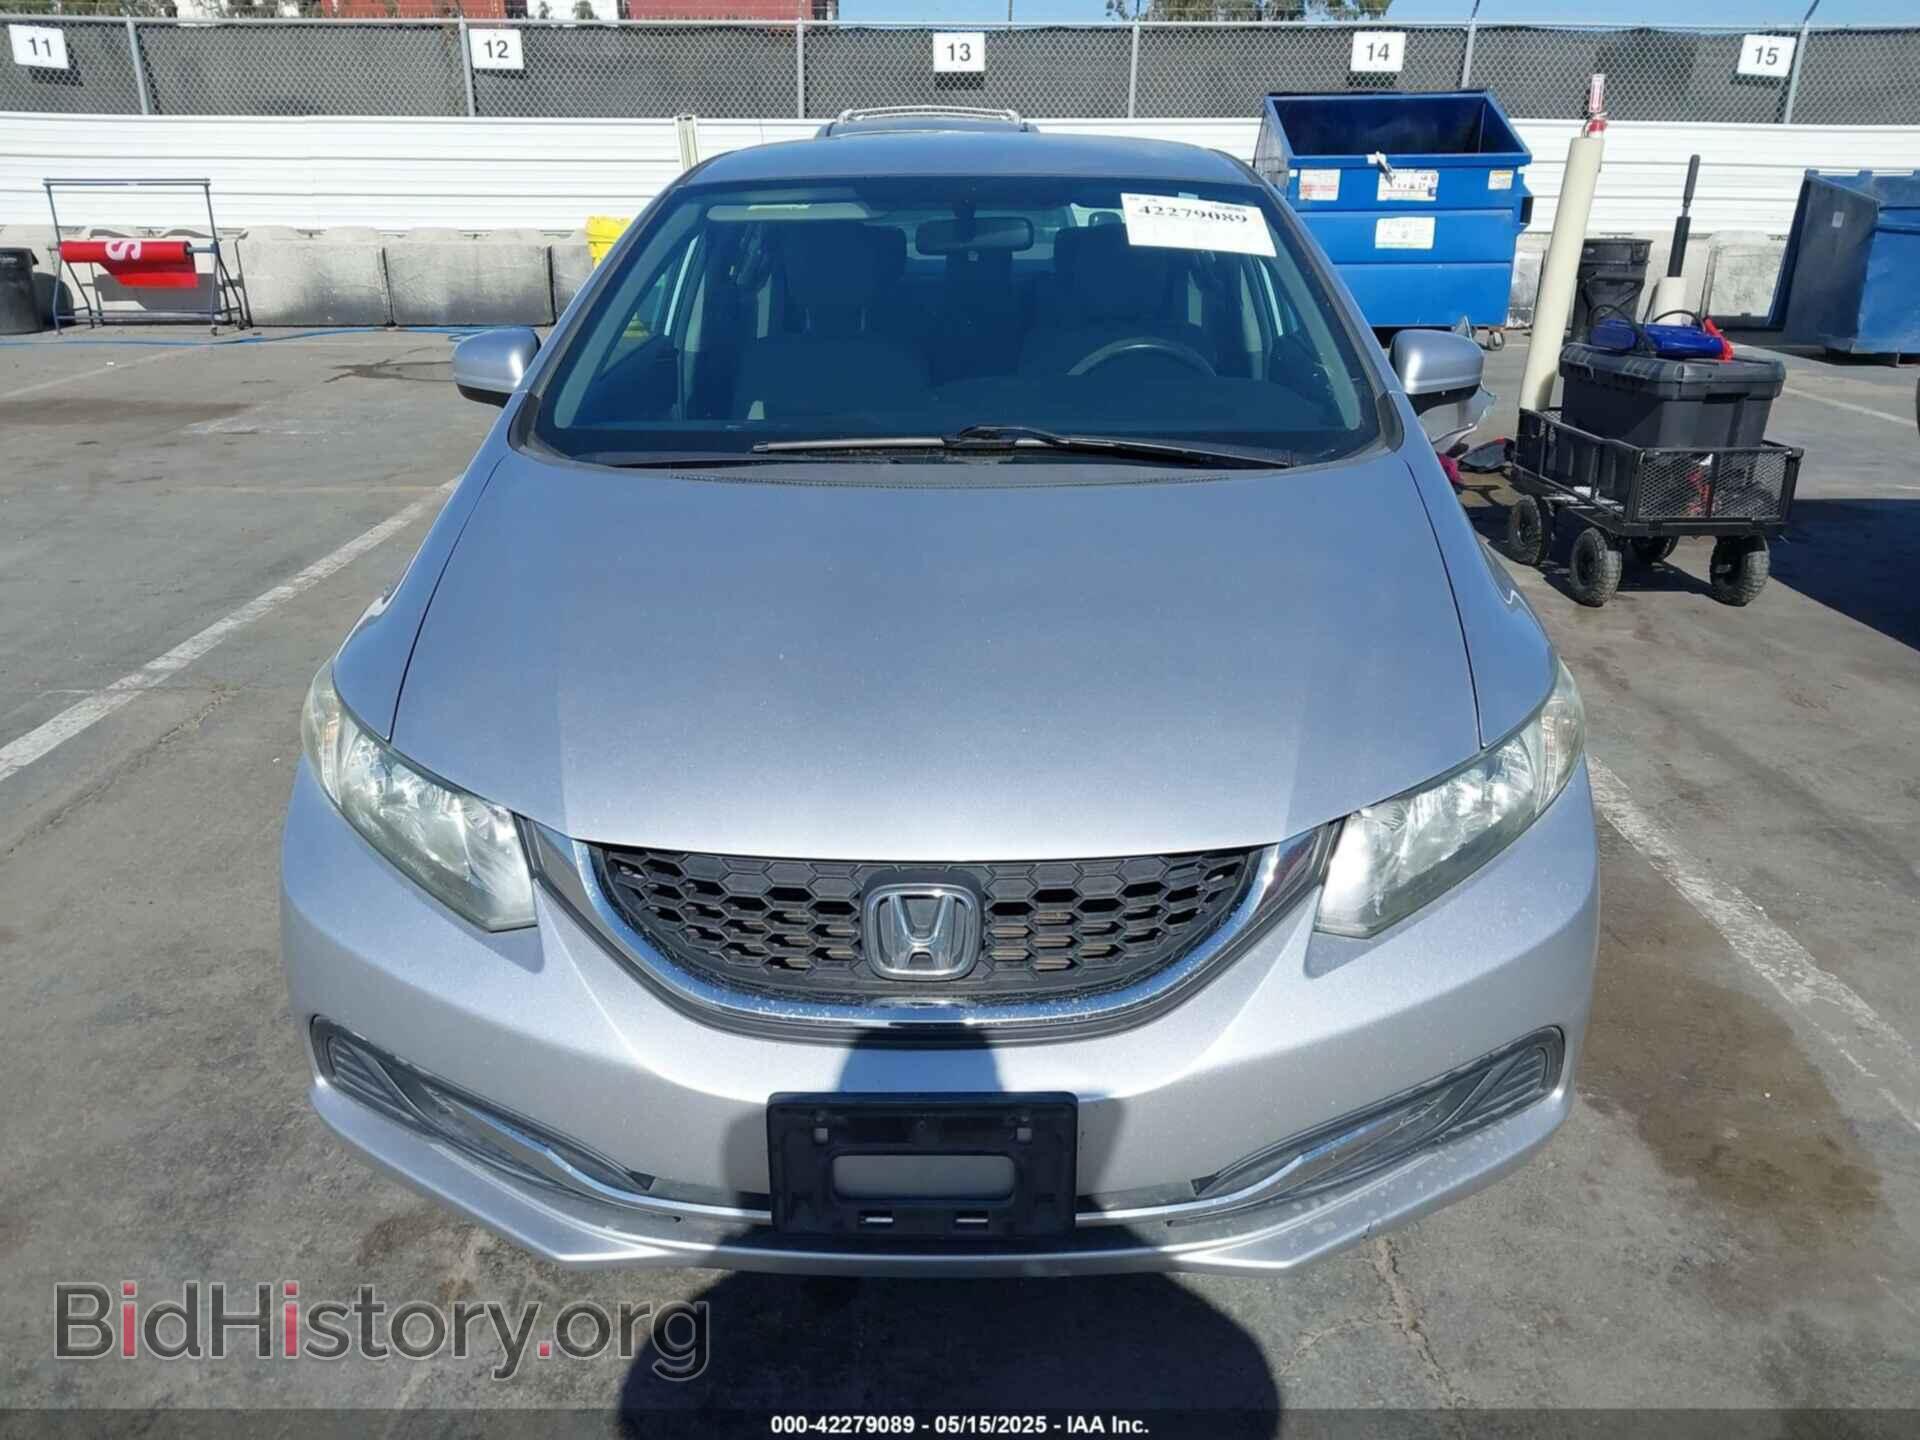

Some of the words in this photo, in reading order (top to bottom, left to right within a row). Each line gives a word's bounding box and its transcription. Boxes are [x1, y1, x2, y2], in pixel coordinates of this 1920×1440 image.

[28, 37, 52, 57] 11
[483, 40, 509, 59] 12
[946, 42, 971, 62] 13
[1366, 42, 1390, 61] 14
[1755, 45, 1780, 66] 15
[1138, 205, 1248, 223] 42279089
